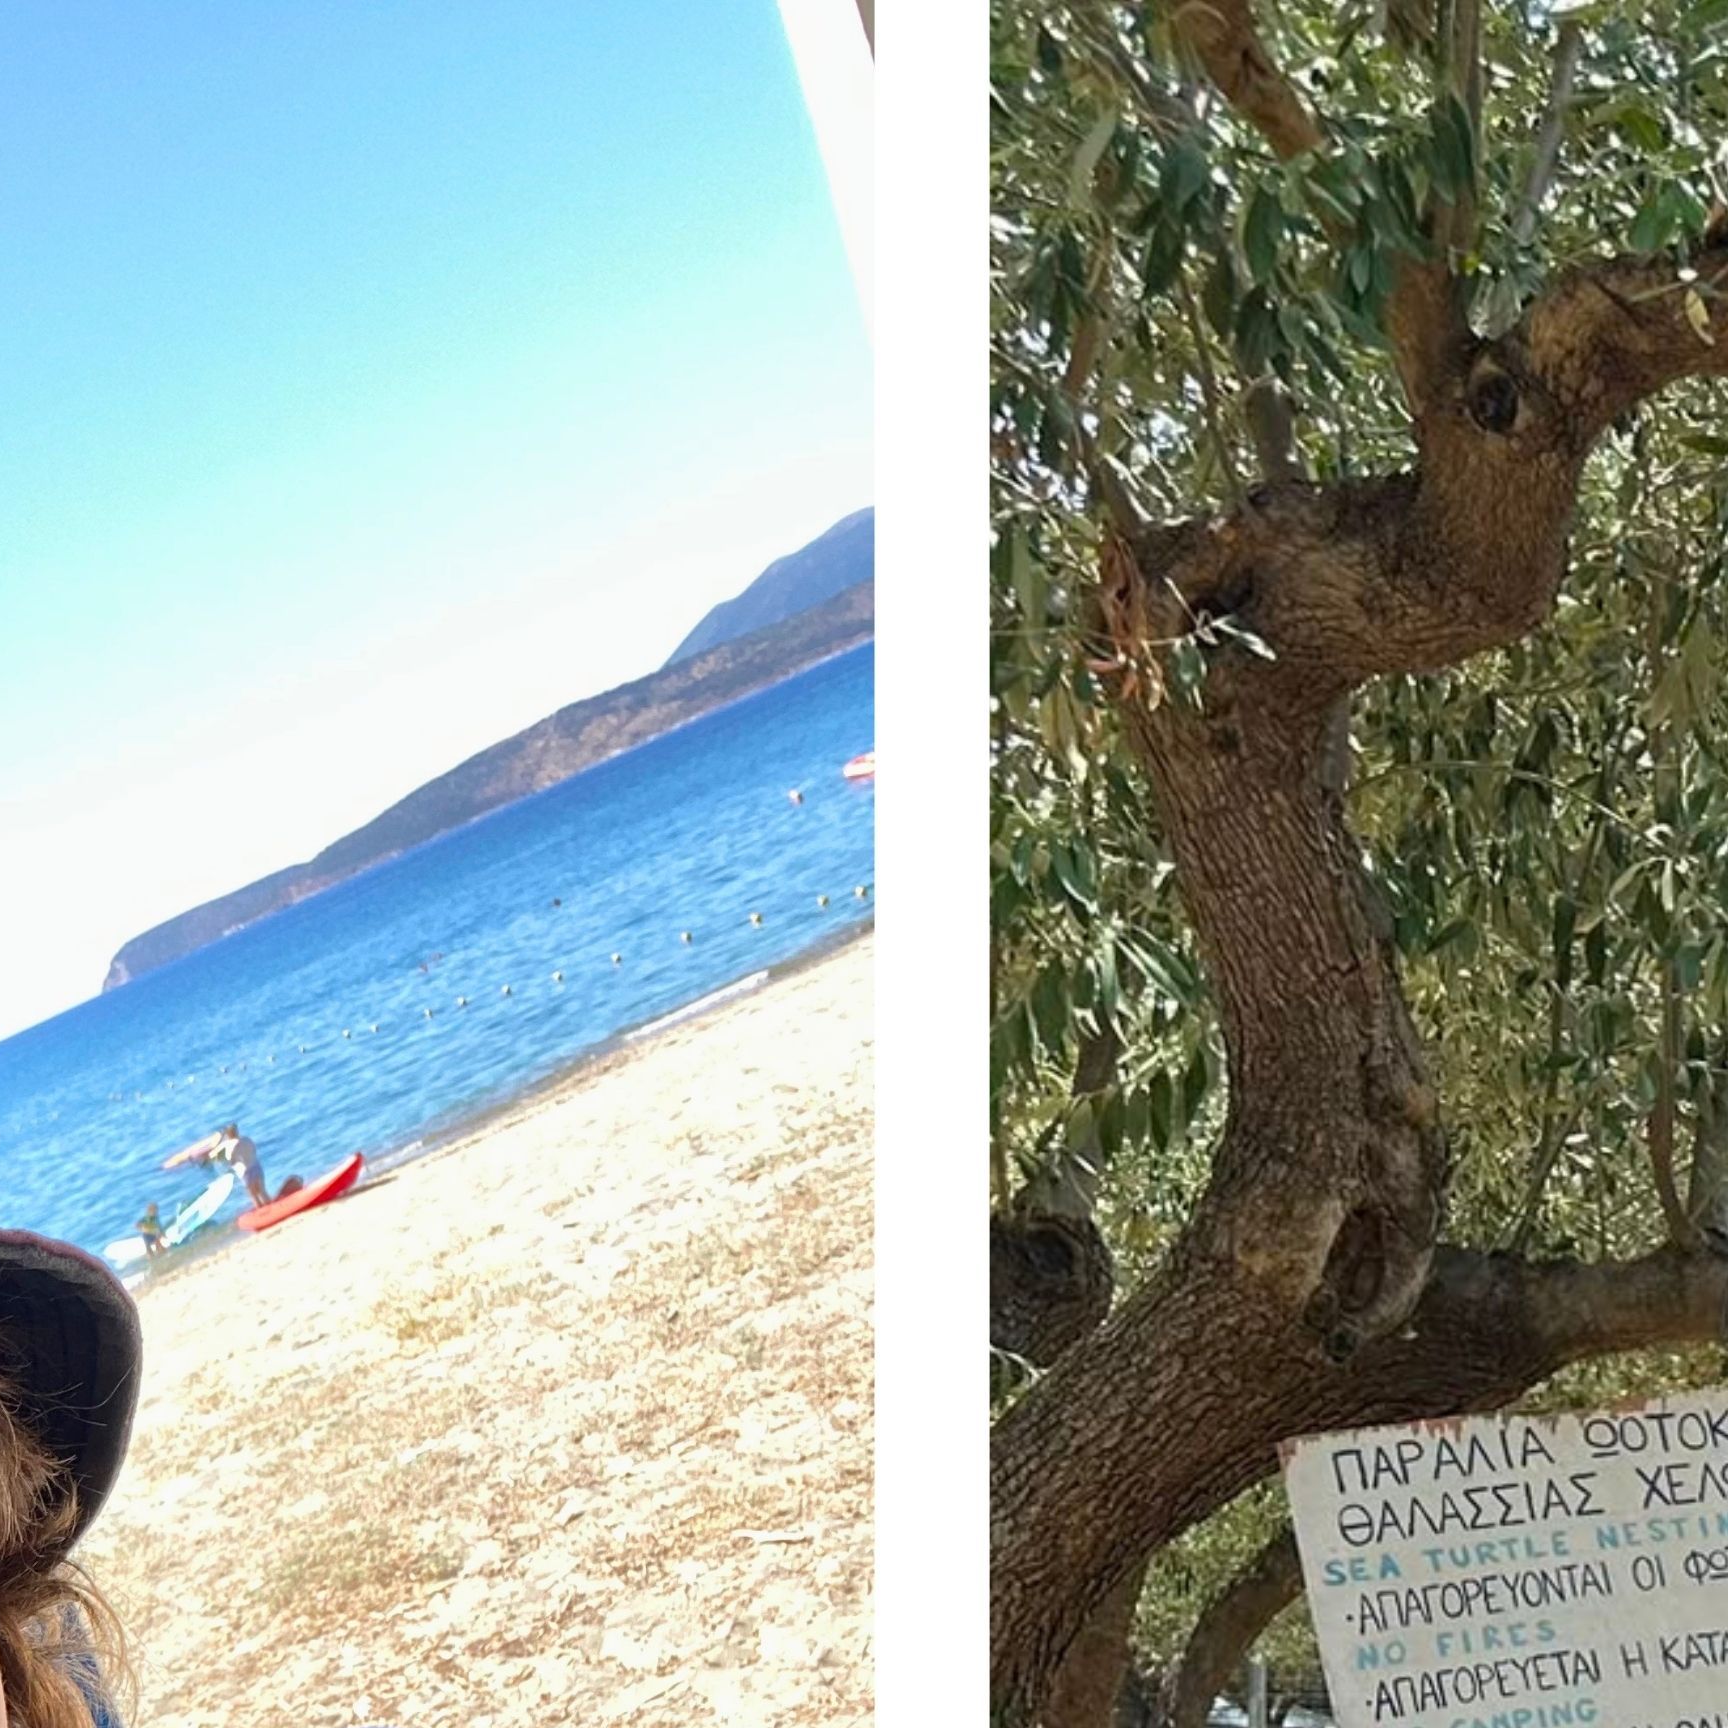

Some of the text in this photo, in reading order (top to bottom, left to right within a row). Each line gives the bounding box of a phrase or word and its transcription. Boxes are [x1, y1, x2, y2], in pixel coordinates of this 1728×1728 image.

[1332, 1426, 1555, 1494] ΠΑΡΑΛΙΑ
[1339, 1472, 1605, 1546] ΘΑΛΑΣΣΙΑΣ
[1323, 1553, 1402, 1587] SEA
[1424, 1530, 1570, 1573] TURTLE
[1632, 1553, 1666, 1591] ΟΙ
[1357, 1619, 1555, 1670] NO FIRES
